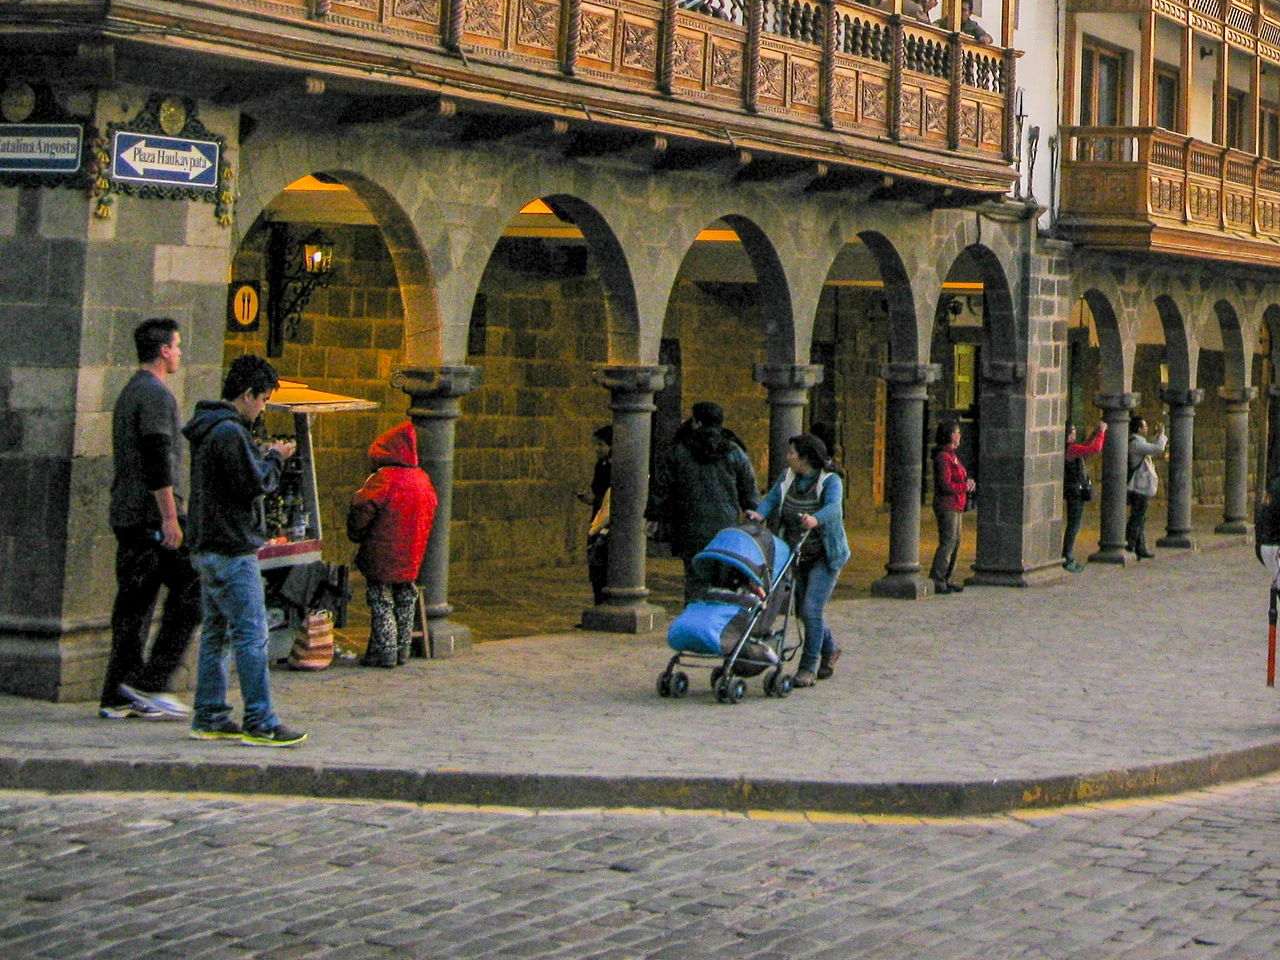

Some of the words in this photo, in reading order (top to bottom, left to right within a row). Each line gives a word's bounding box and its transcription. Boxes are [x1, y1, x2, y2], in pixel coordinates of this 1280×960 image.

[0, 138, 35, 153] atalina
[133, 147, 156, 163] Plaza
[157, 150, 207, 171] Haukaypata
